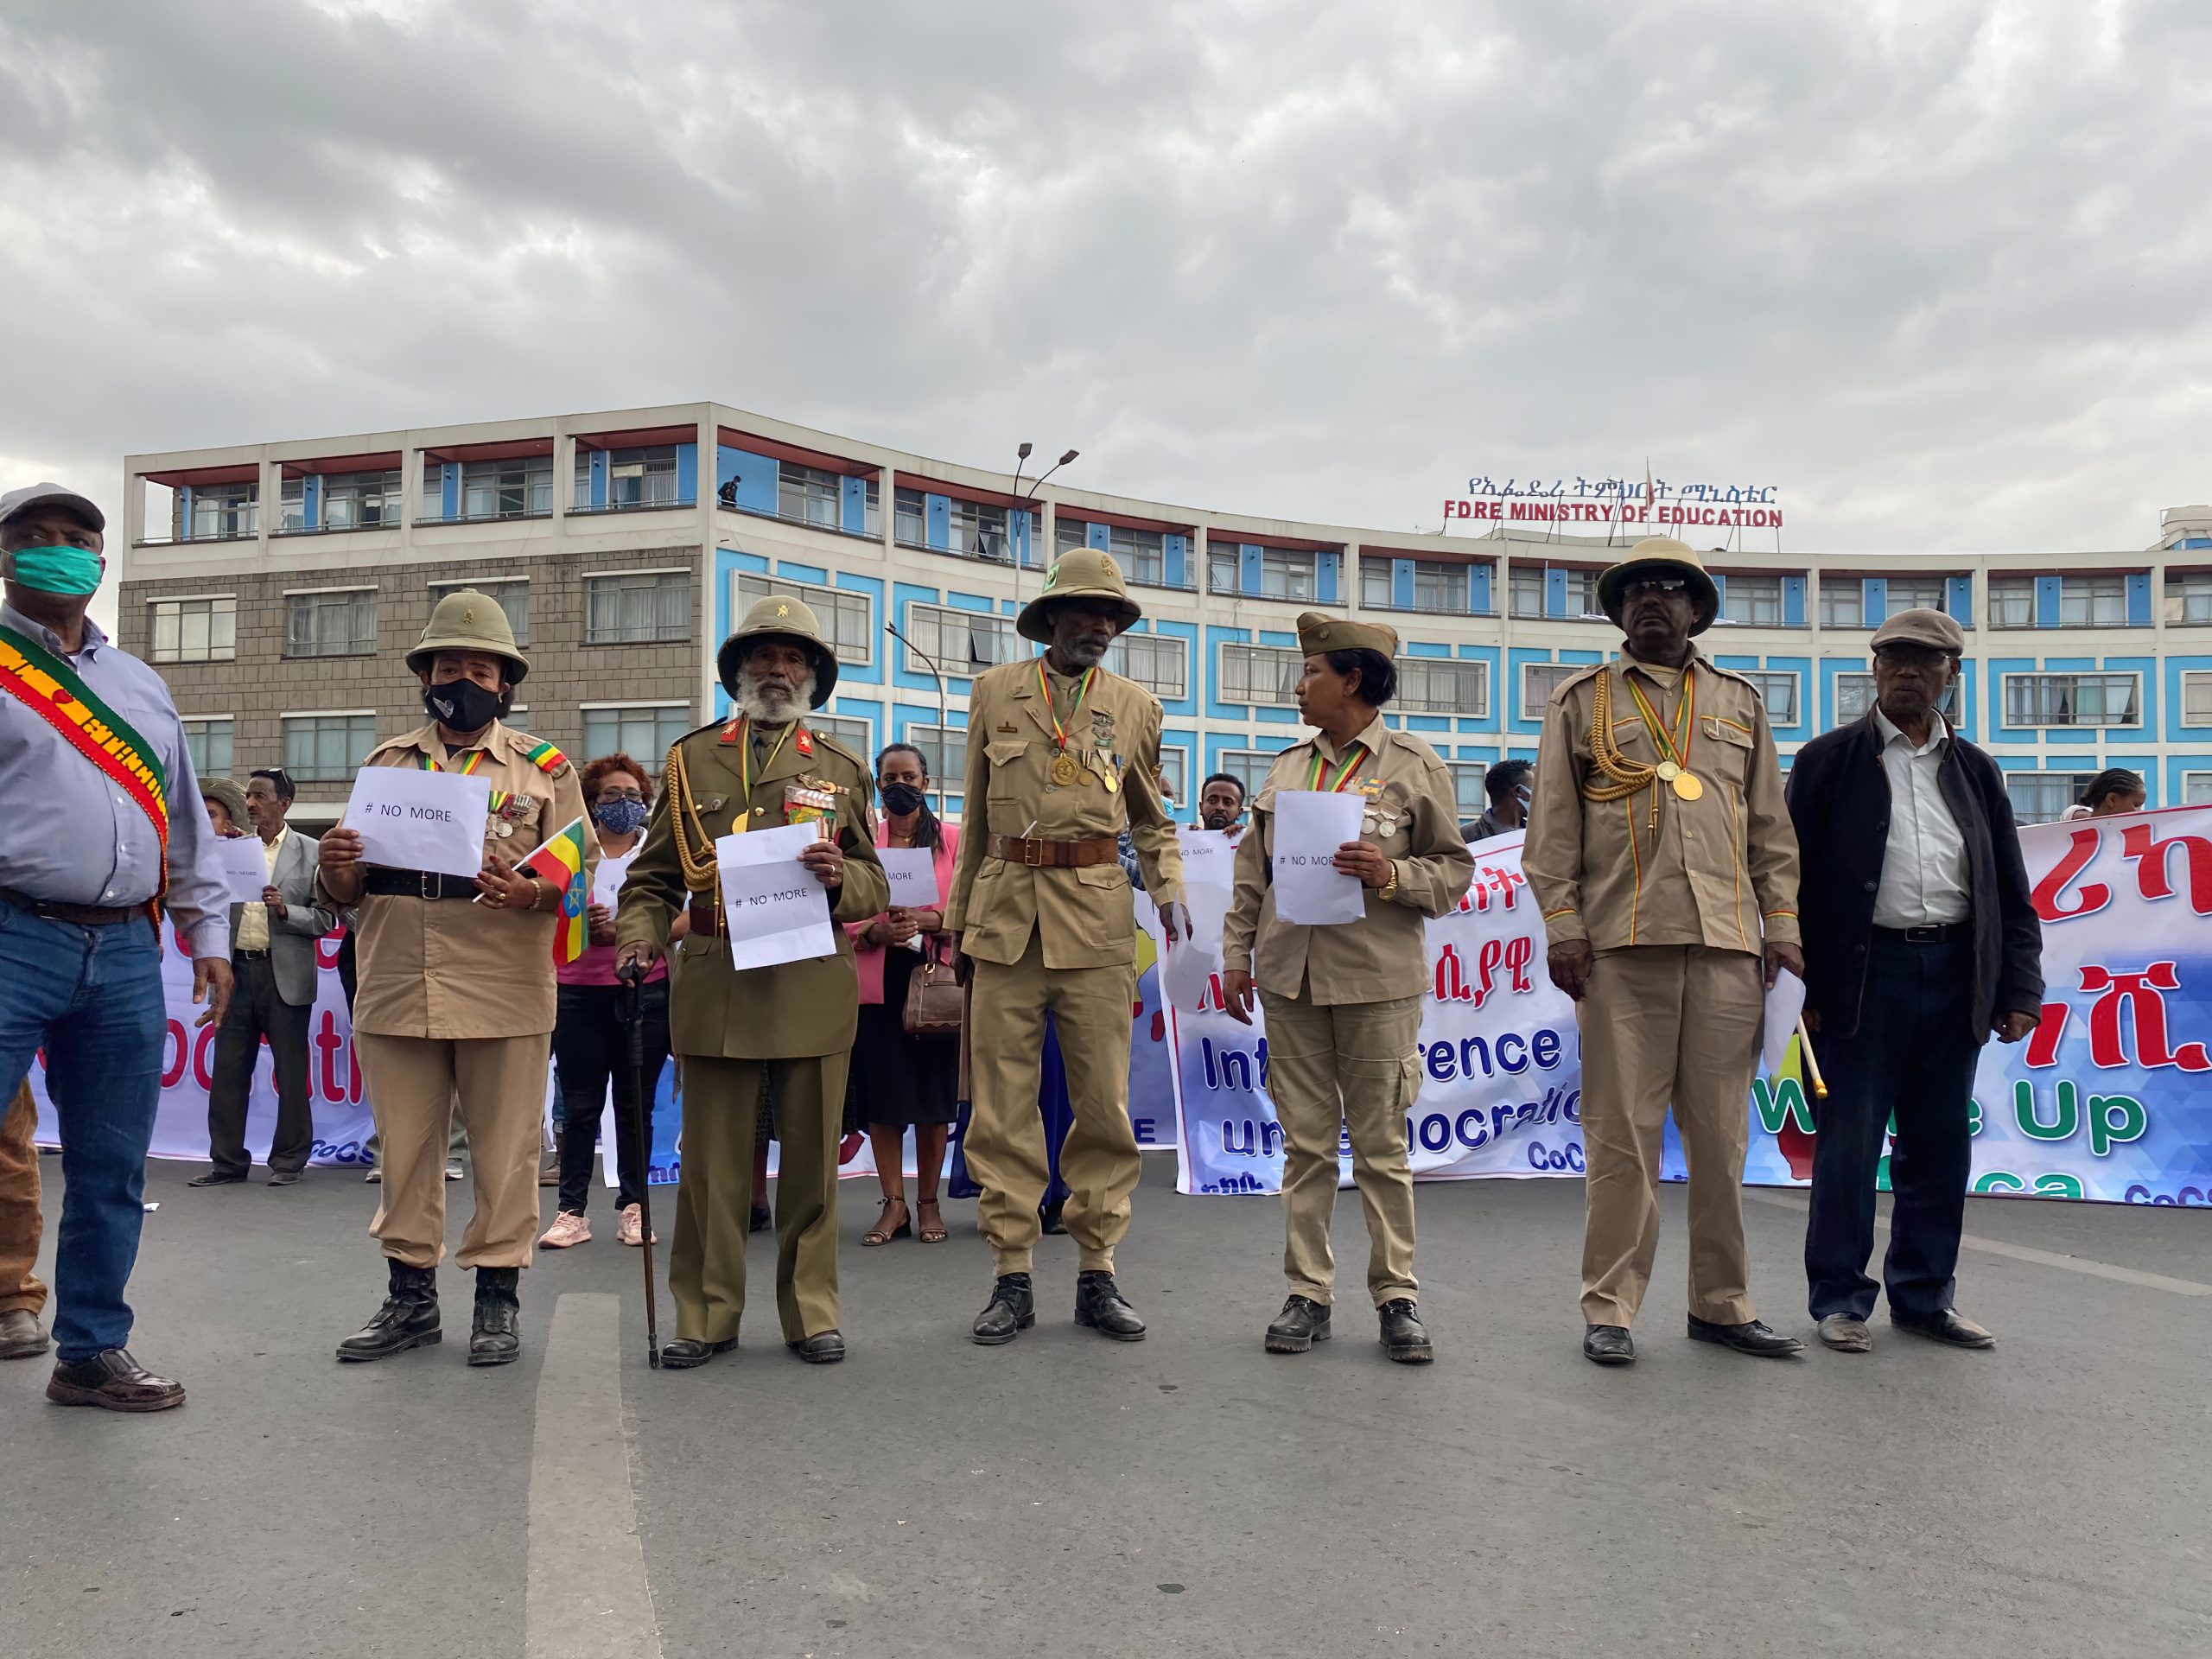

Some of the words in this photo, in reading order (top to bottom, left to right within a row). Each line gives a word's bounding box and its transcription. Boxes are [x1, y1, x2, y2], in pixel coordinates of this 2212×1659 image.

[1444, 500, 1503, 520] FDRE
[1510, 503, 1614, 522] MINISTRY
[1622, 505, 1649, 524] OF
[1658, 506, 1783, 527] EDUCATION
[380, 804, 402, 817] NO
[410, 806, 452, 823] MORE
[1291, 855, 1306, 866] NO
[1311, 855, 1335, 866] MOR
[887, 872, 914, 880] MORE
[749, 894, 768, 906] NO
[773, 887, 809, 902] MORE
[2013, 1079, 2149, 1156] Up
